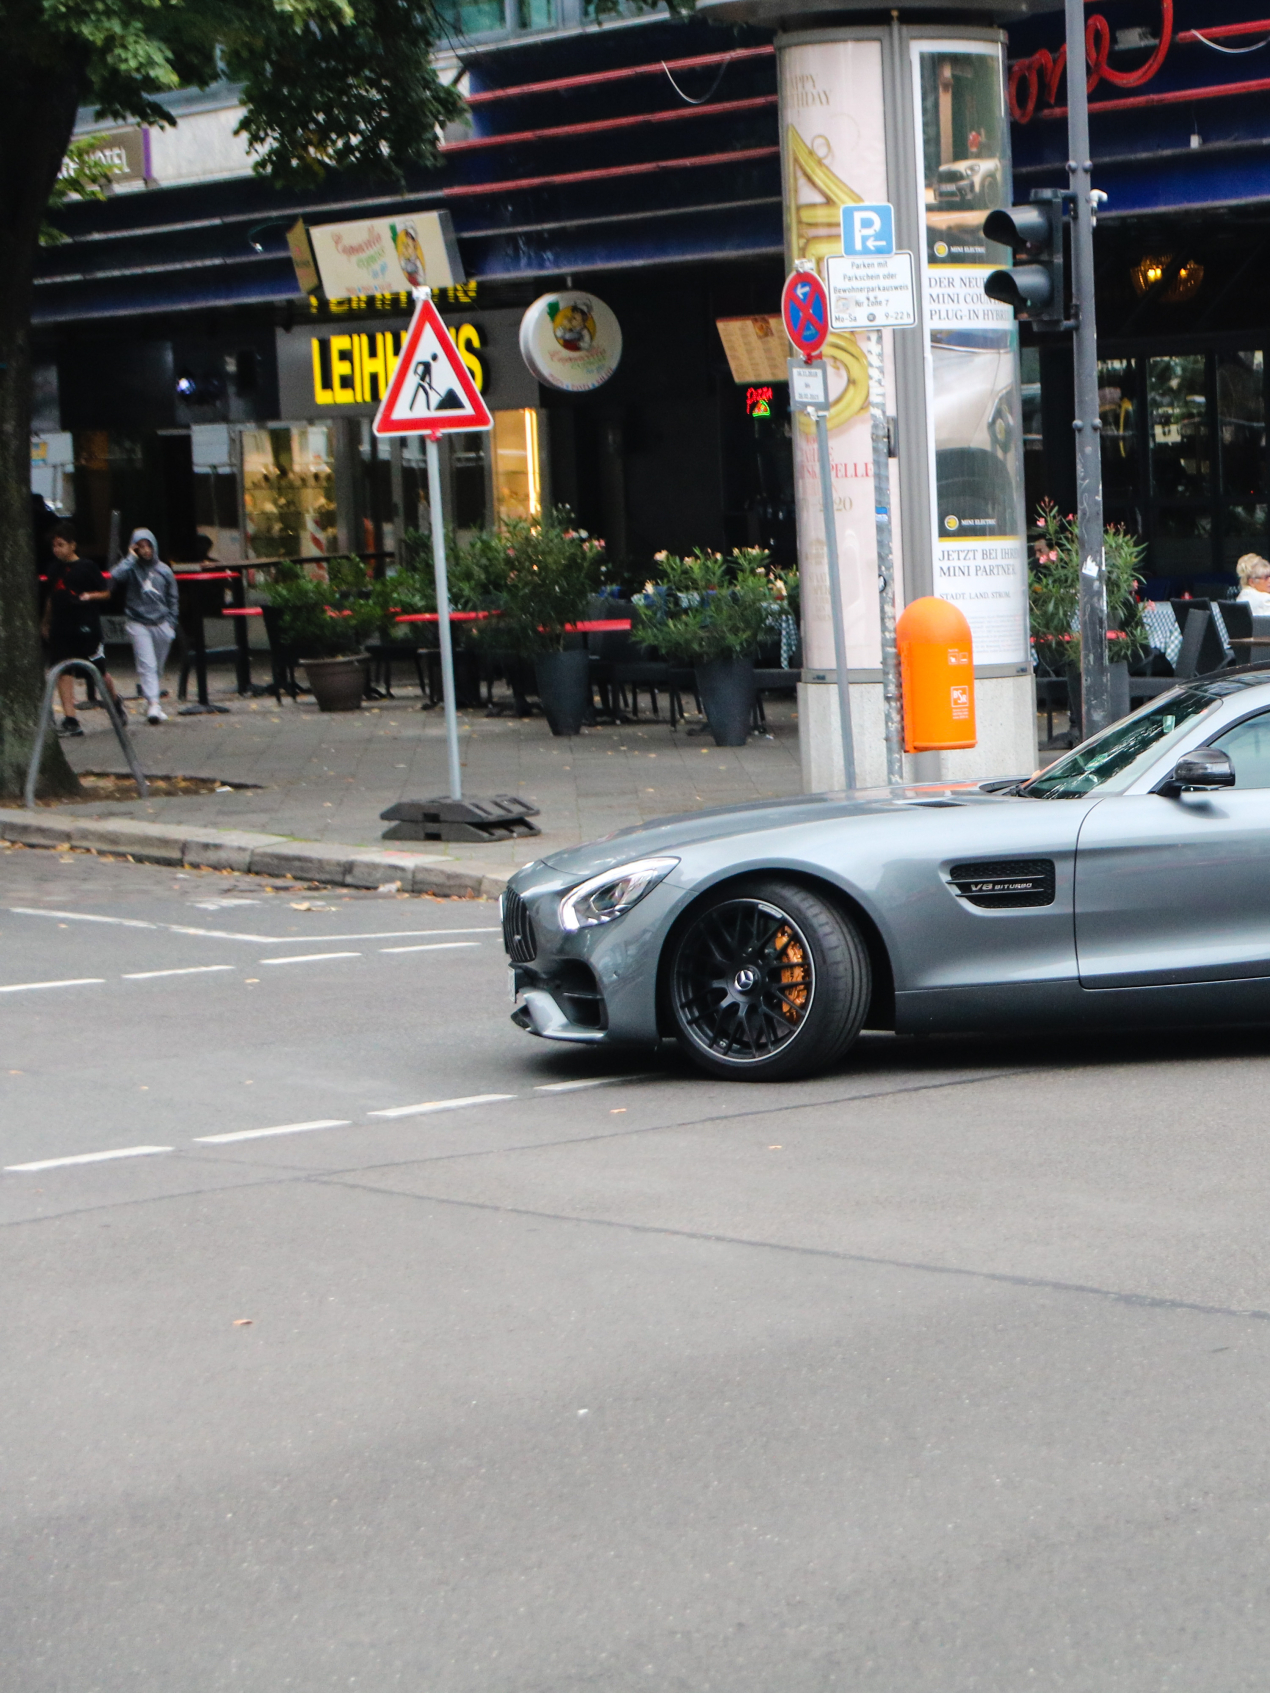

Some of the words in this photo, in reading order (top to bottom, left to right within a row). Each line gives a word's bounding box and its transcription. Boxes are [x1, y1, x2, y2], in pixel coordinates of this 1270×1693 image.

[851, 261, 875, 269] Parken
[877, 260, 888, 268] mit
[843, 273, 880, 281] Parkschein
[882, 272, 897, 280] oder
[928, 277, 955, 288] DER
[833, 284, 909, 294] Bewohnerparkausweis
[929, 293, 960, 304] MINI
[834, 313, 857, 323] Mo-Sa
[929, 309, 979, 320] PLUG-IN
[938, 549, 978, 561] JETZT
[981, 548, 998, 560] BEI
[939, 565, 971, 577] MINI
[971, 883, 993, 891] V8
